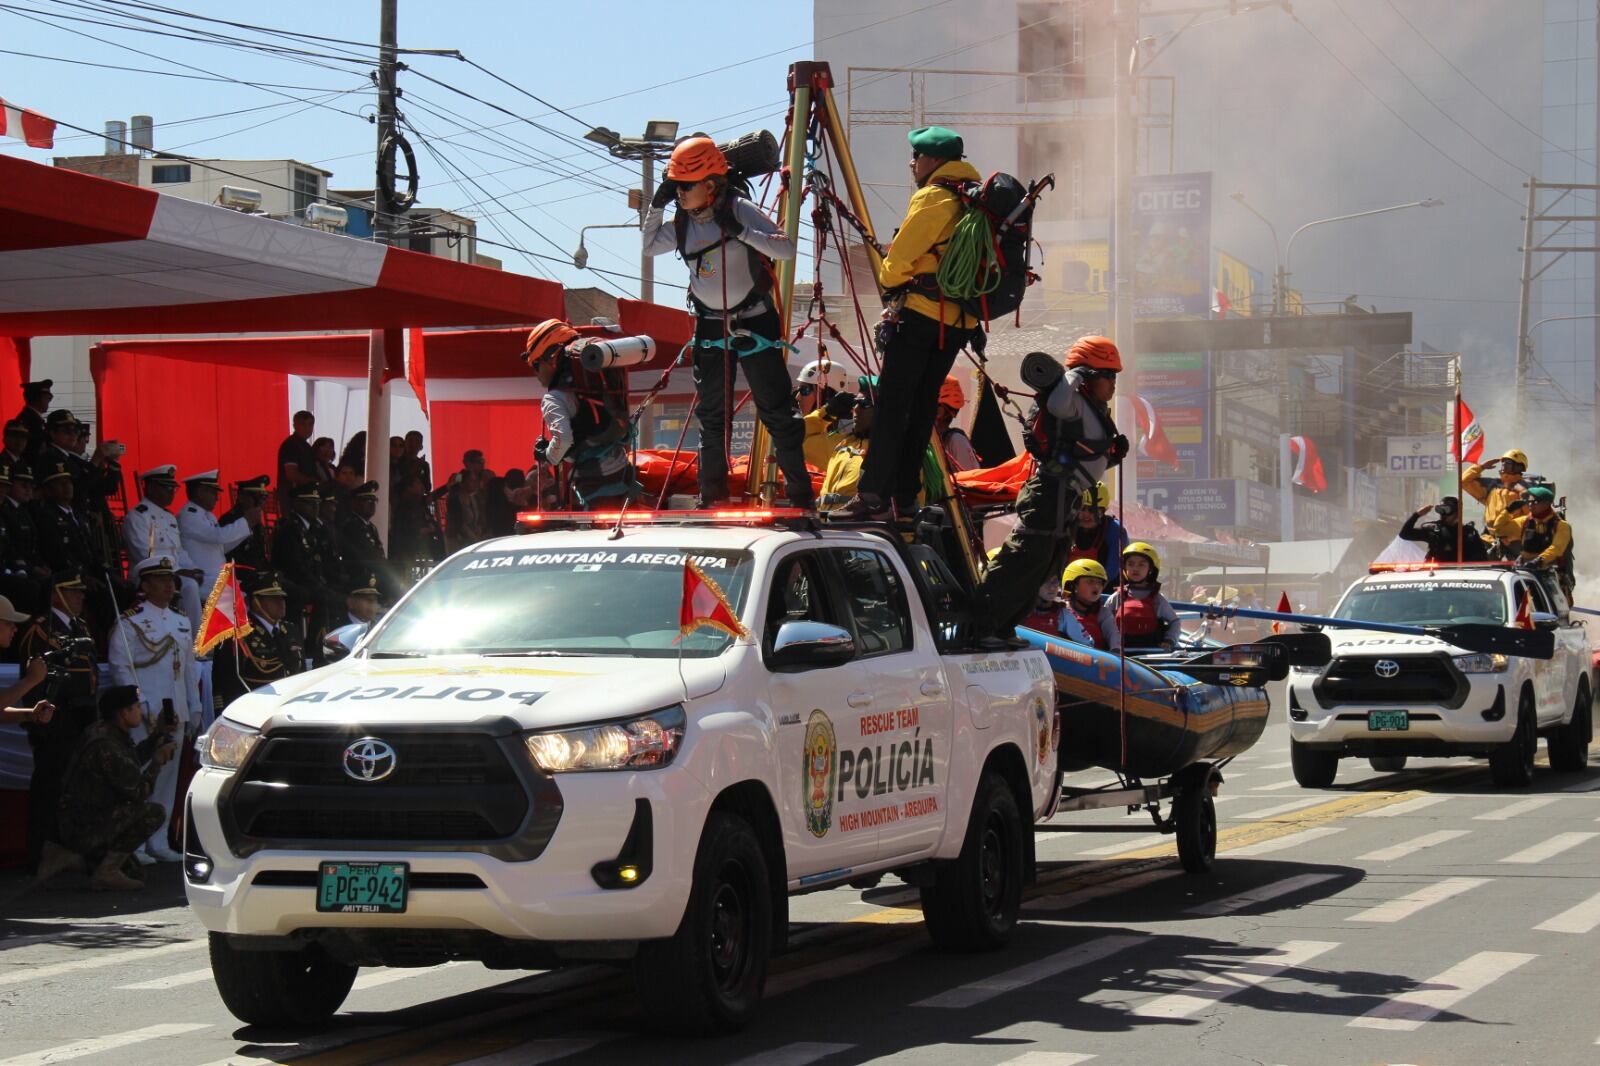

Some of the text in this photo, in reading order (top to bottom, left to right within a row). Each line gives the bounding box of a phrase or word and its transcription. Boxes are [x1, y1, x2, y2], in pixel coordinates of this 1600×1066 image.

[1138, 189, 1201, 211] CITEC
[1390, 455, 1442, 471] CITEC
[463, 551, 728, 571] ALTA MONTAÑA AREQUIPA
[1362, 584, 1388, 592] ALTA
[1389, 581, 1439, 590] MONTAÑA
[1440, 581, 1493, 590] AREQUIPA
[860, 707, 920, 736] RESCUE TEAM
[1376, 715, 1405, 727] PG-901
[837, 726, 935, 802] POLICÍA
[840, 813, 860, 832] HIGH
[861, 804, 899, 827] MOUNTAIN
[904, 796, 938, 818] AREQUIPA
[336, 875, 404, 903] PG-942
[341, 904, 380, 913] MITSUI
